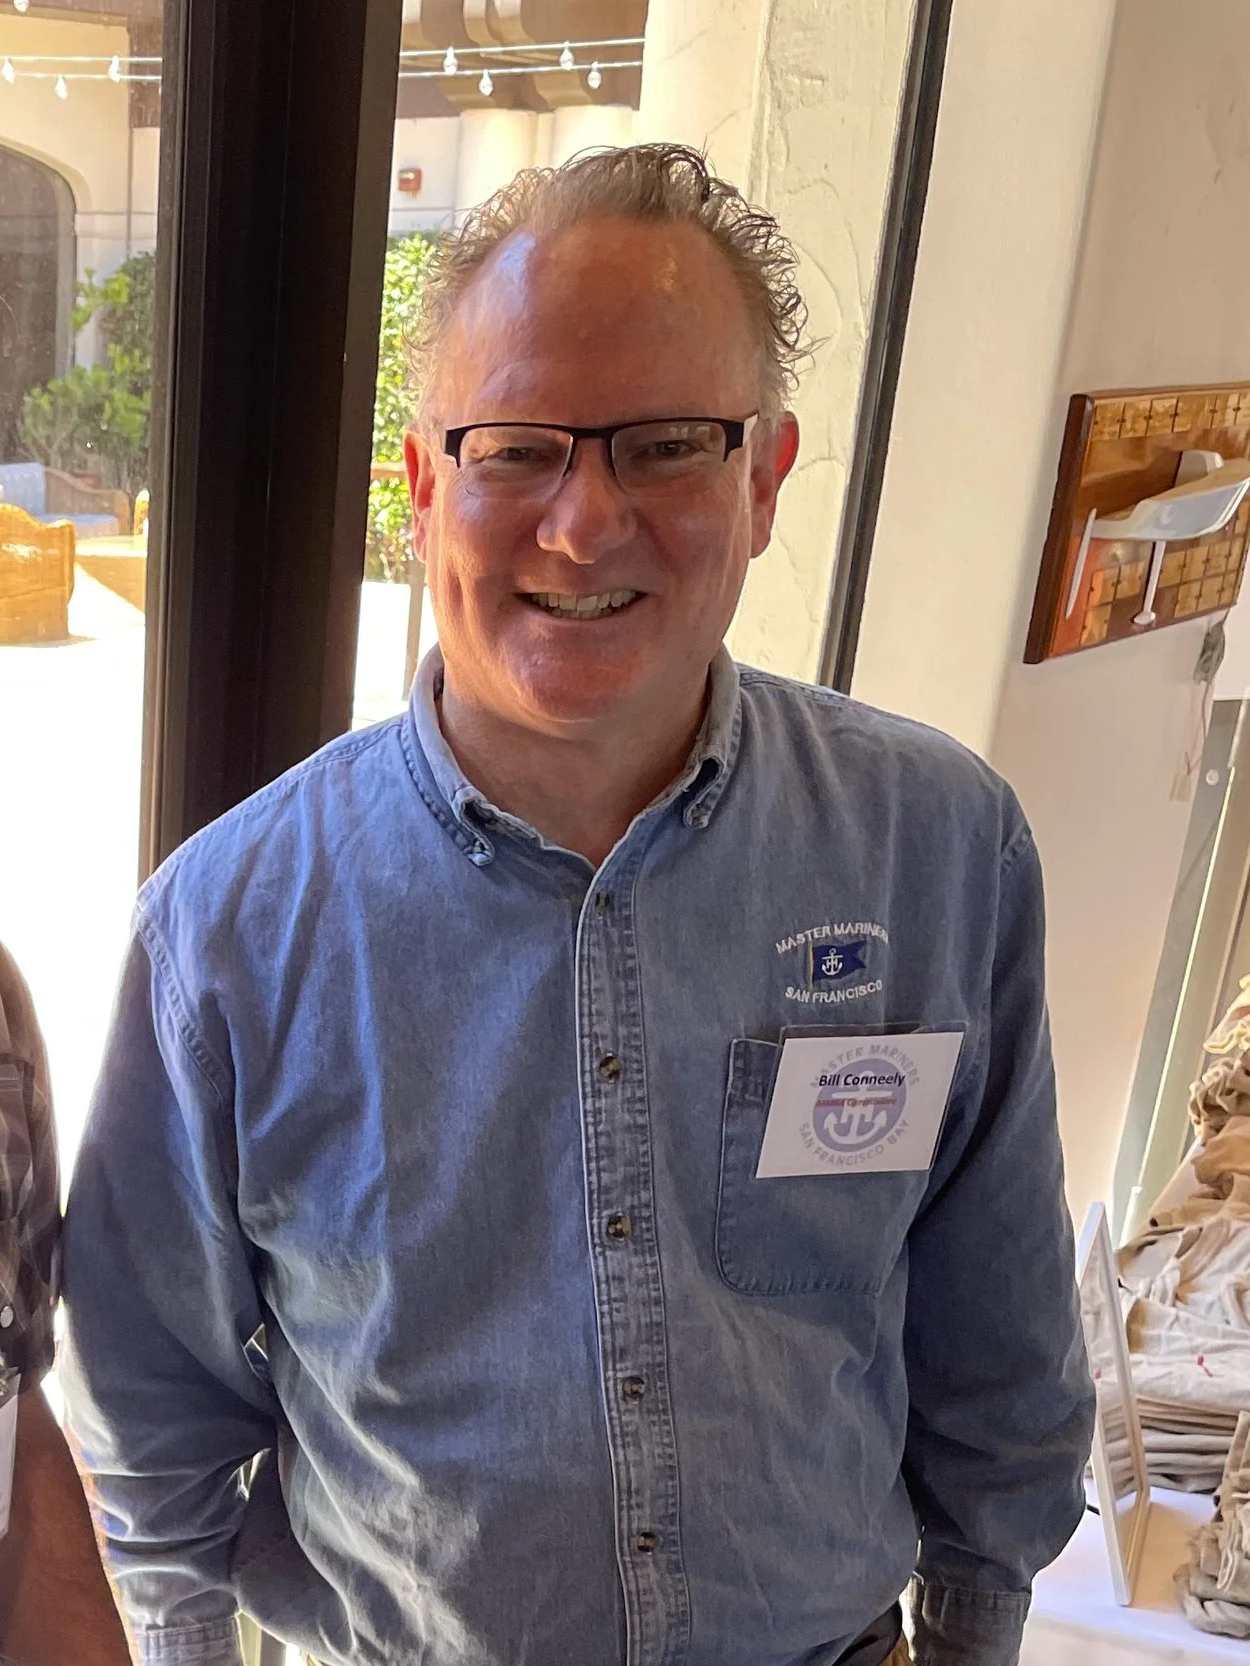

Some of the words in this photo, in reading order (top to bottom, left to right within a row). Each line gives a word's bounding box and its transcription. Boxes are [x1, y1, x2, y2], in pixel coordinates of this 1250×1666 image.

[775, 925, 831, 954] MASTER
[785, 986, 810, 1003] SAN
[812, 979, 883, 1003] FRANCISCO
[818, 1073, 841, 1087] Bill
[843, 1072, 906, 1087] Conneely
[869, 1044, 920, 1087] MARINERS
[812, 1144, 884, 1166] FRANCISCO
[886, 1119, 909, 1145] BAY
